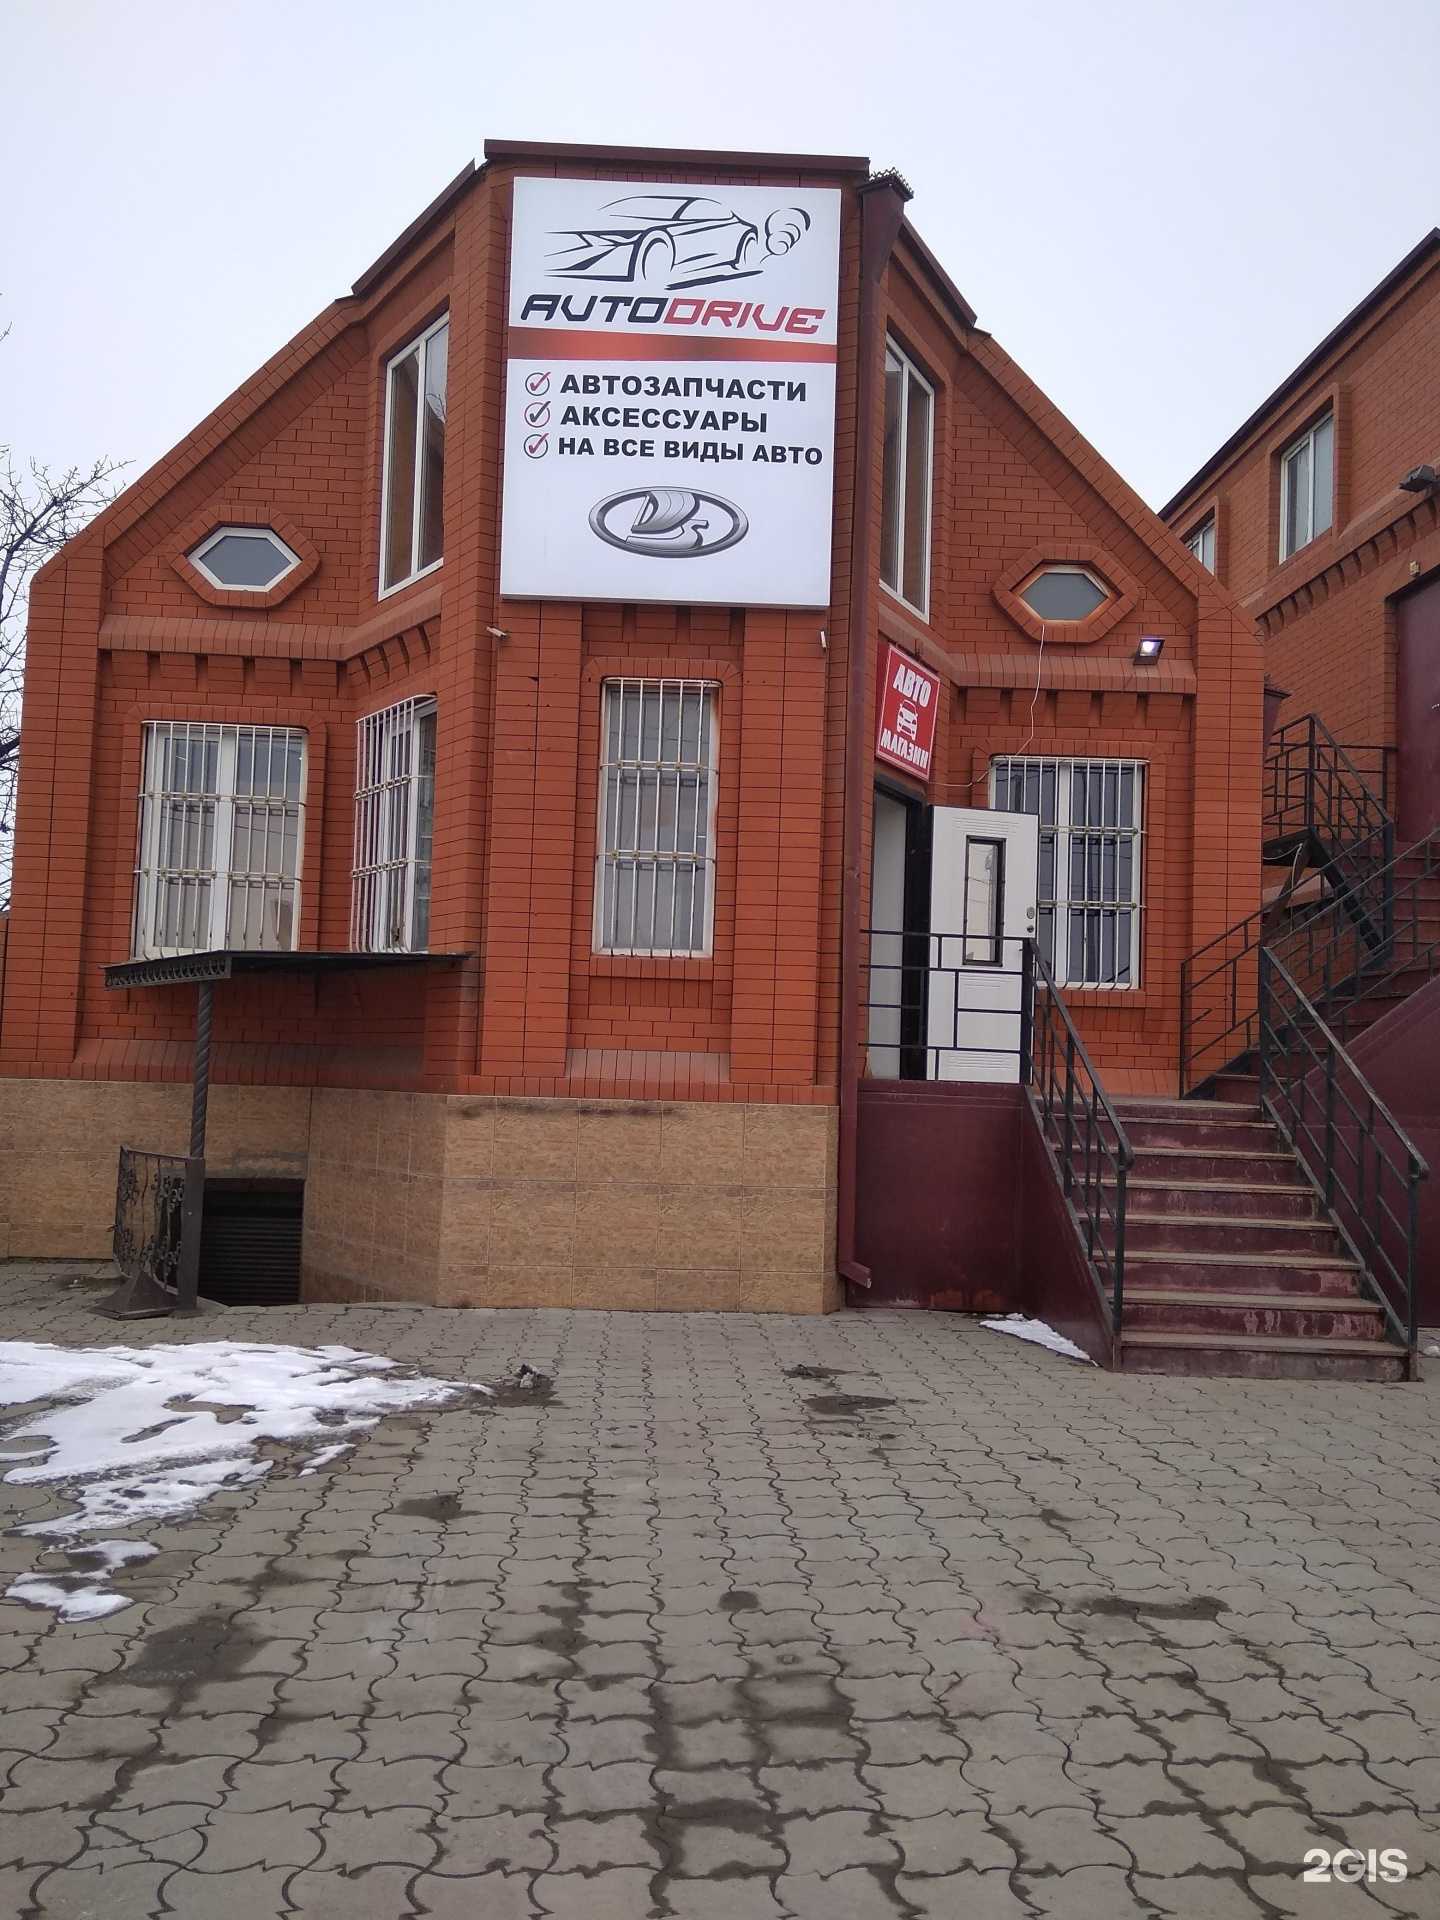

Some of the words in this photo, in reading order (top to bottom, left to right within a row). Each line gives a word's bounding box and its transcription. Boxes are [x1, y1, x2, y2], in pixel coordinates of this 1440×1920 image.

[560, 374, 806, 402] АВТОЗАПЧАСТИ
[560, 405, 768, 433] АКСЕССУАРЫ
[558, 437, 595, 456] НА
[603, 439, 655, 458] ВСЕ
[663, 441, 744, 463] ВИДЫ
[752, 443, 823, 466] АВТО
[892, 663, 931, 707] АВТО
[880, 728, 929, 769] МАГАЗИН
